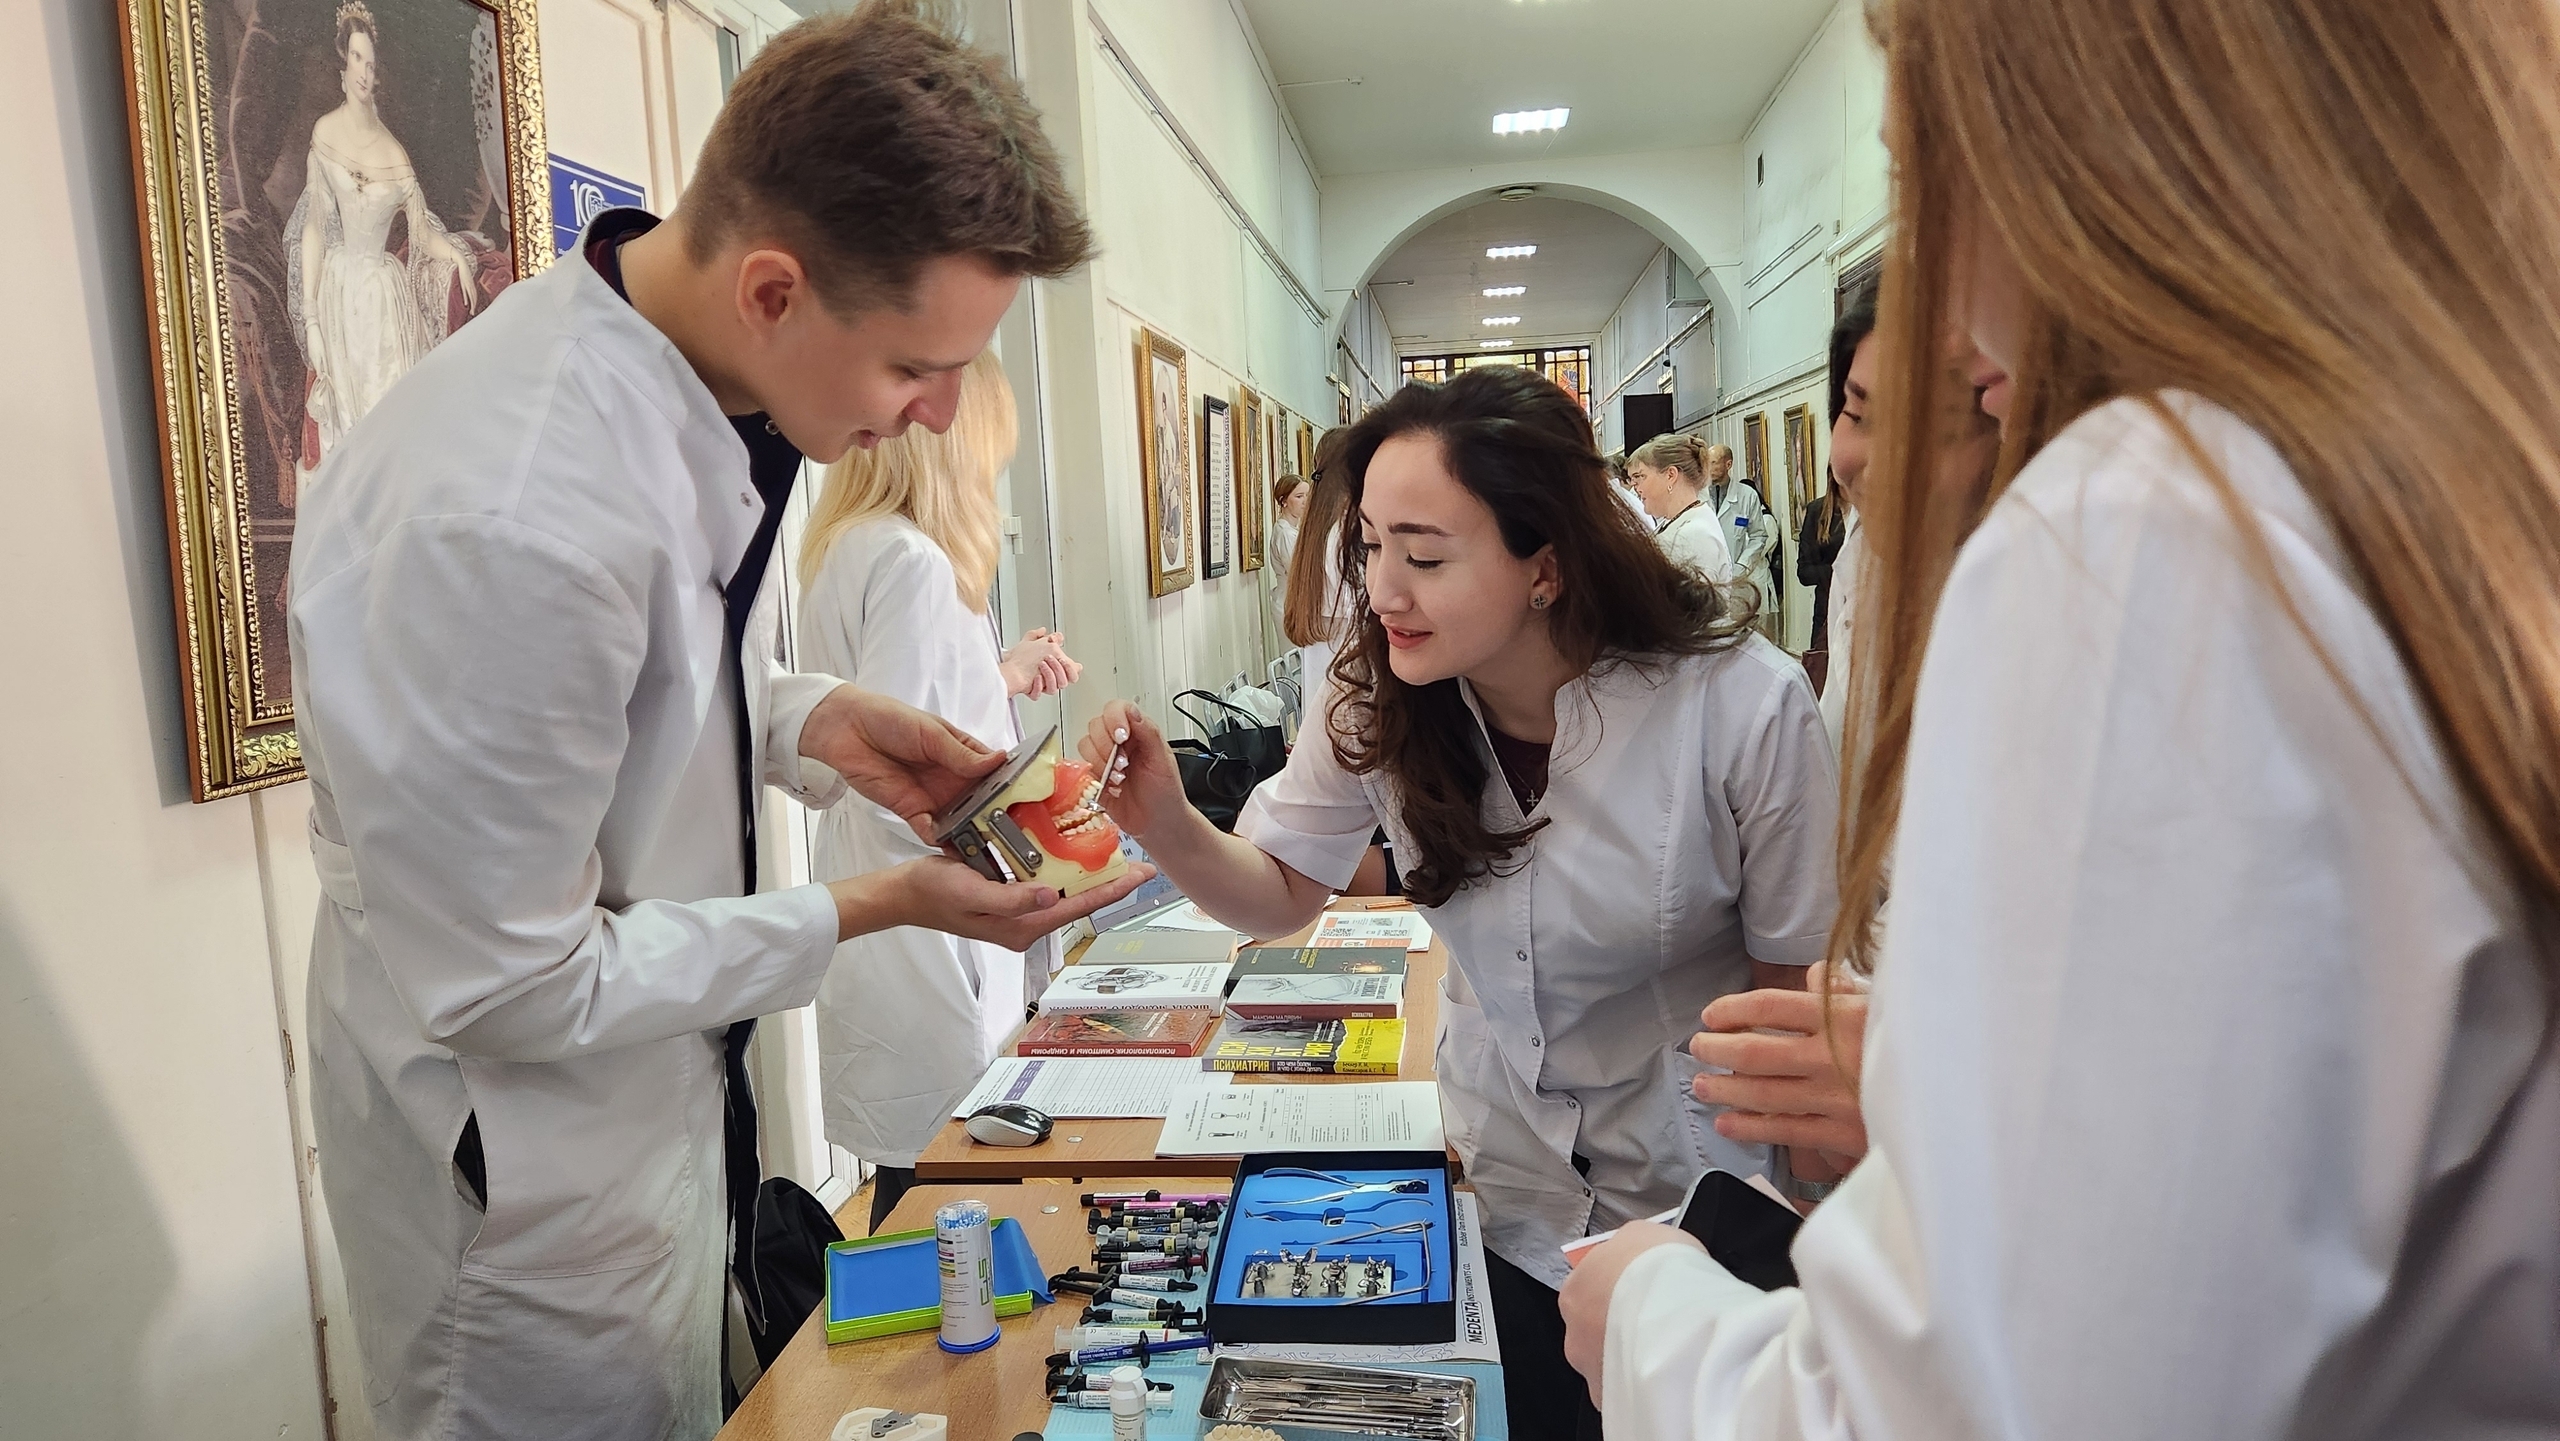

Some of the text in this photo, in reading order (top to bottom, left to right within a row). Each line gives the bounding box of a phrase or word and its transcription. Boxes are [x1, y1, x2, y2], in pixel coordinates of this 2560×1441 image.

[1031, 1047, 1068, 1055] СИНДРОМЫ
[1076, 1047, 1114, 1055] СИМПТОМЫ
[1213, 1060, 1270, 1072] ПСИХИАТРИЯ
[1458, 1222, 1467, 1231] Dam
[1460, 1231, 1469, 1247] Rubber
[1464, 1301, 1484, 1344] MEDENTA
